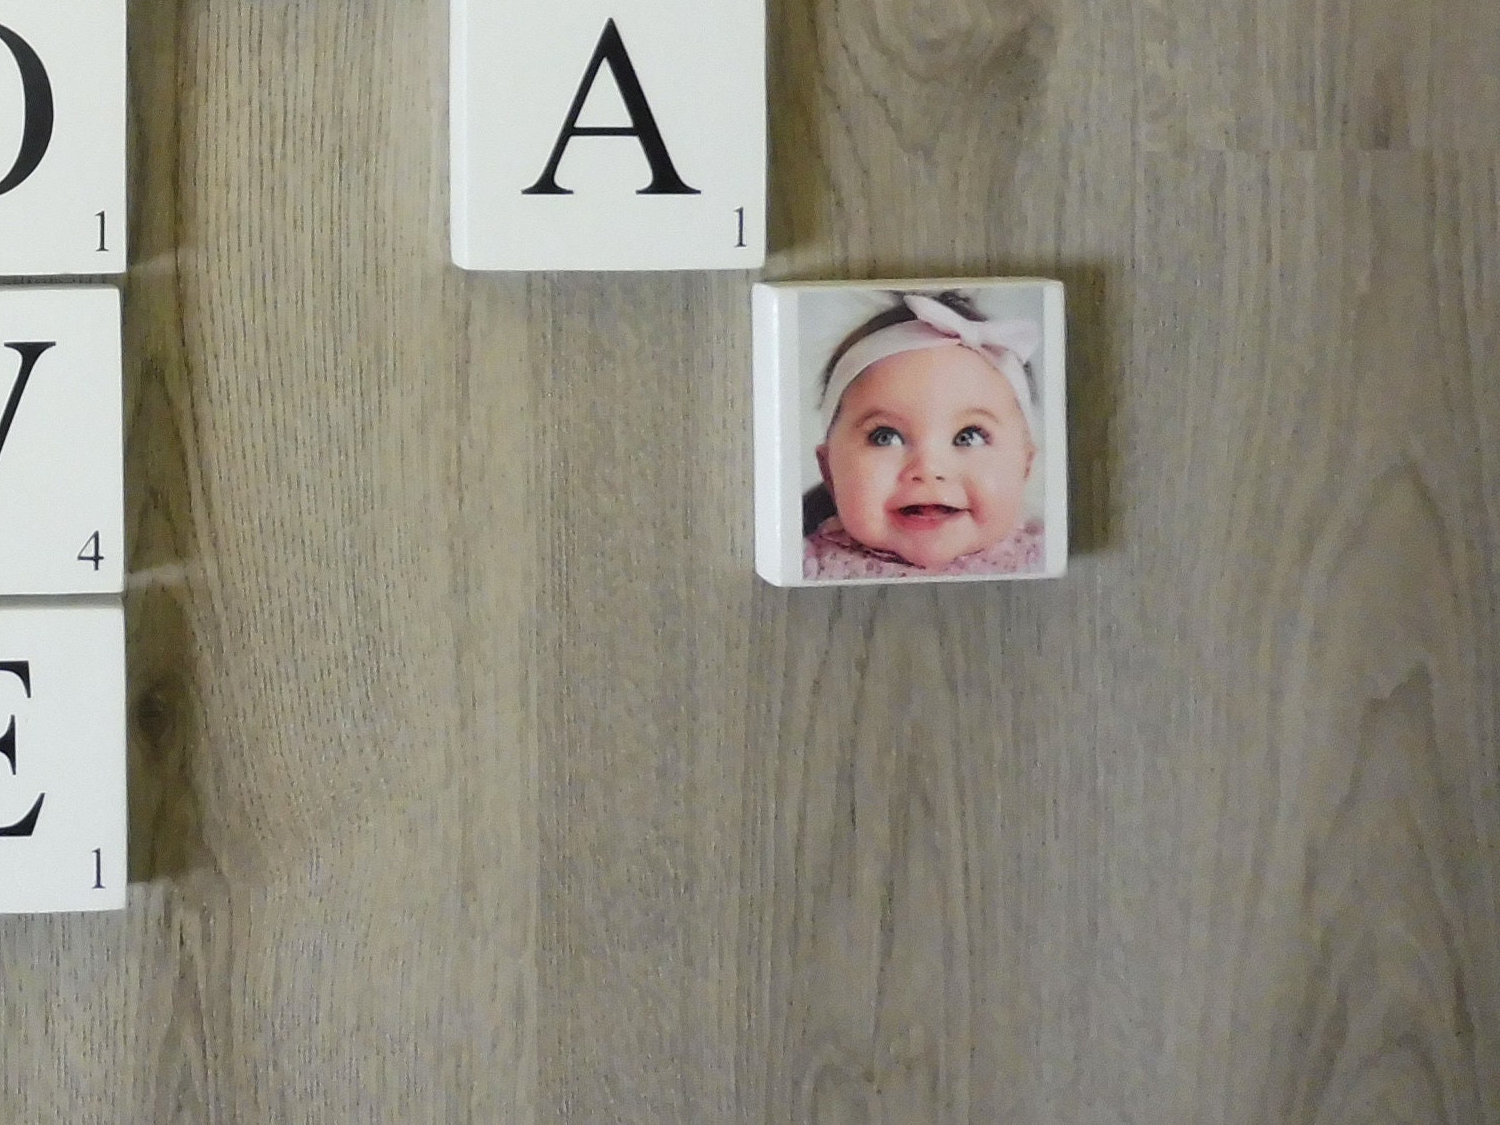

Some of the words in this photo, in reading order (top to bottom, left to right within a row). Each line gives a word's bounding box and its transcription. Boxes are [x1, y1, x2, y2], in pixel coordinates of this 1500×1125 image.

[520, 16, 702, 196] A
[94, 210, 110, 253] 1
[733, 206, 748, 249] 1
[76, 529, 105, 572] 4
[91, 847, 107, 890] 1
